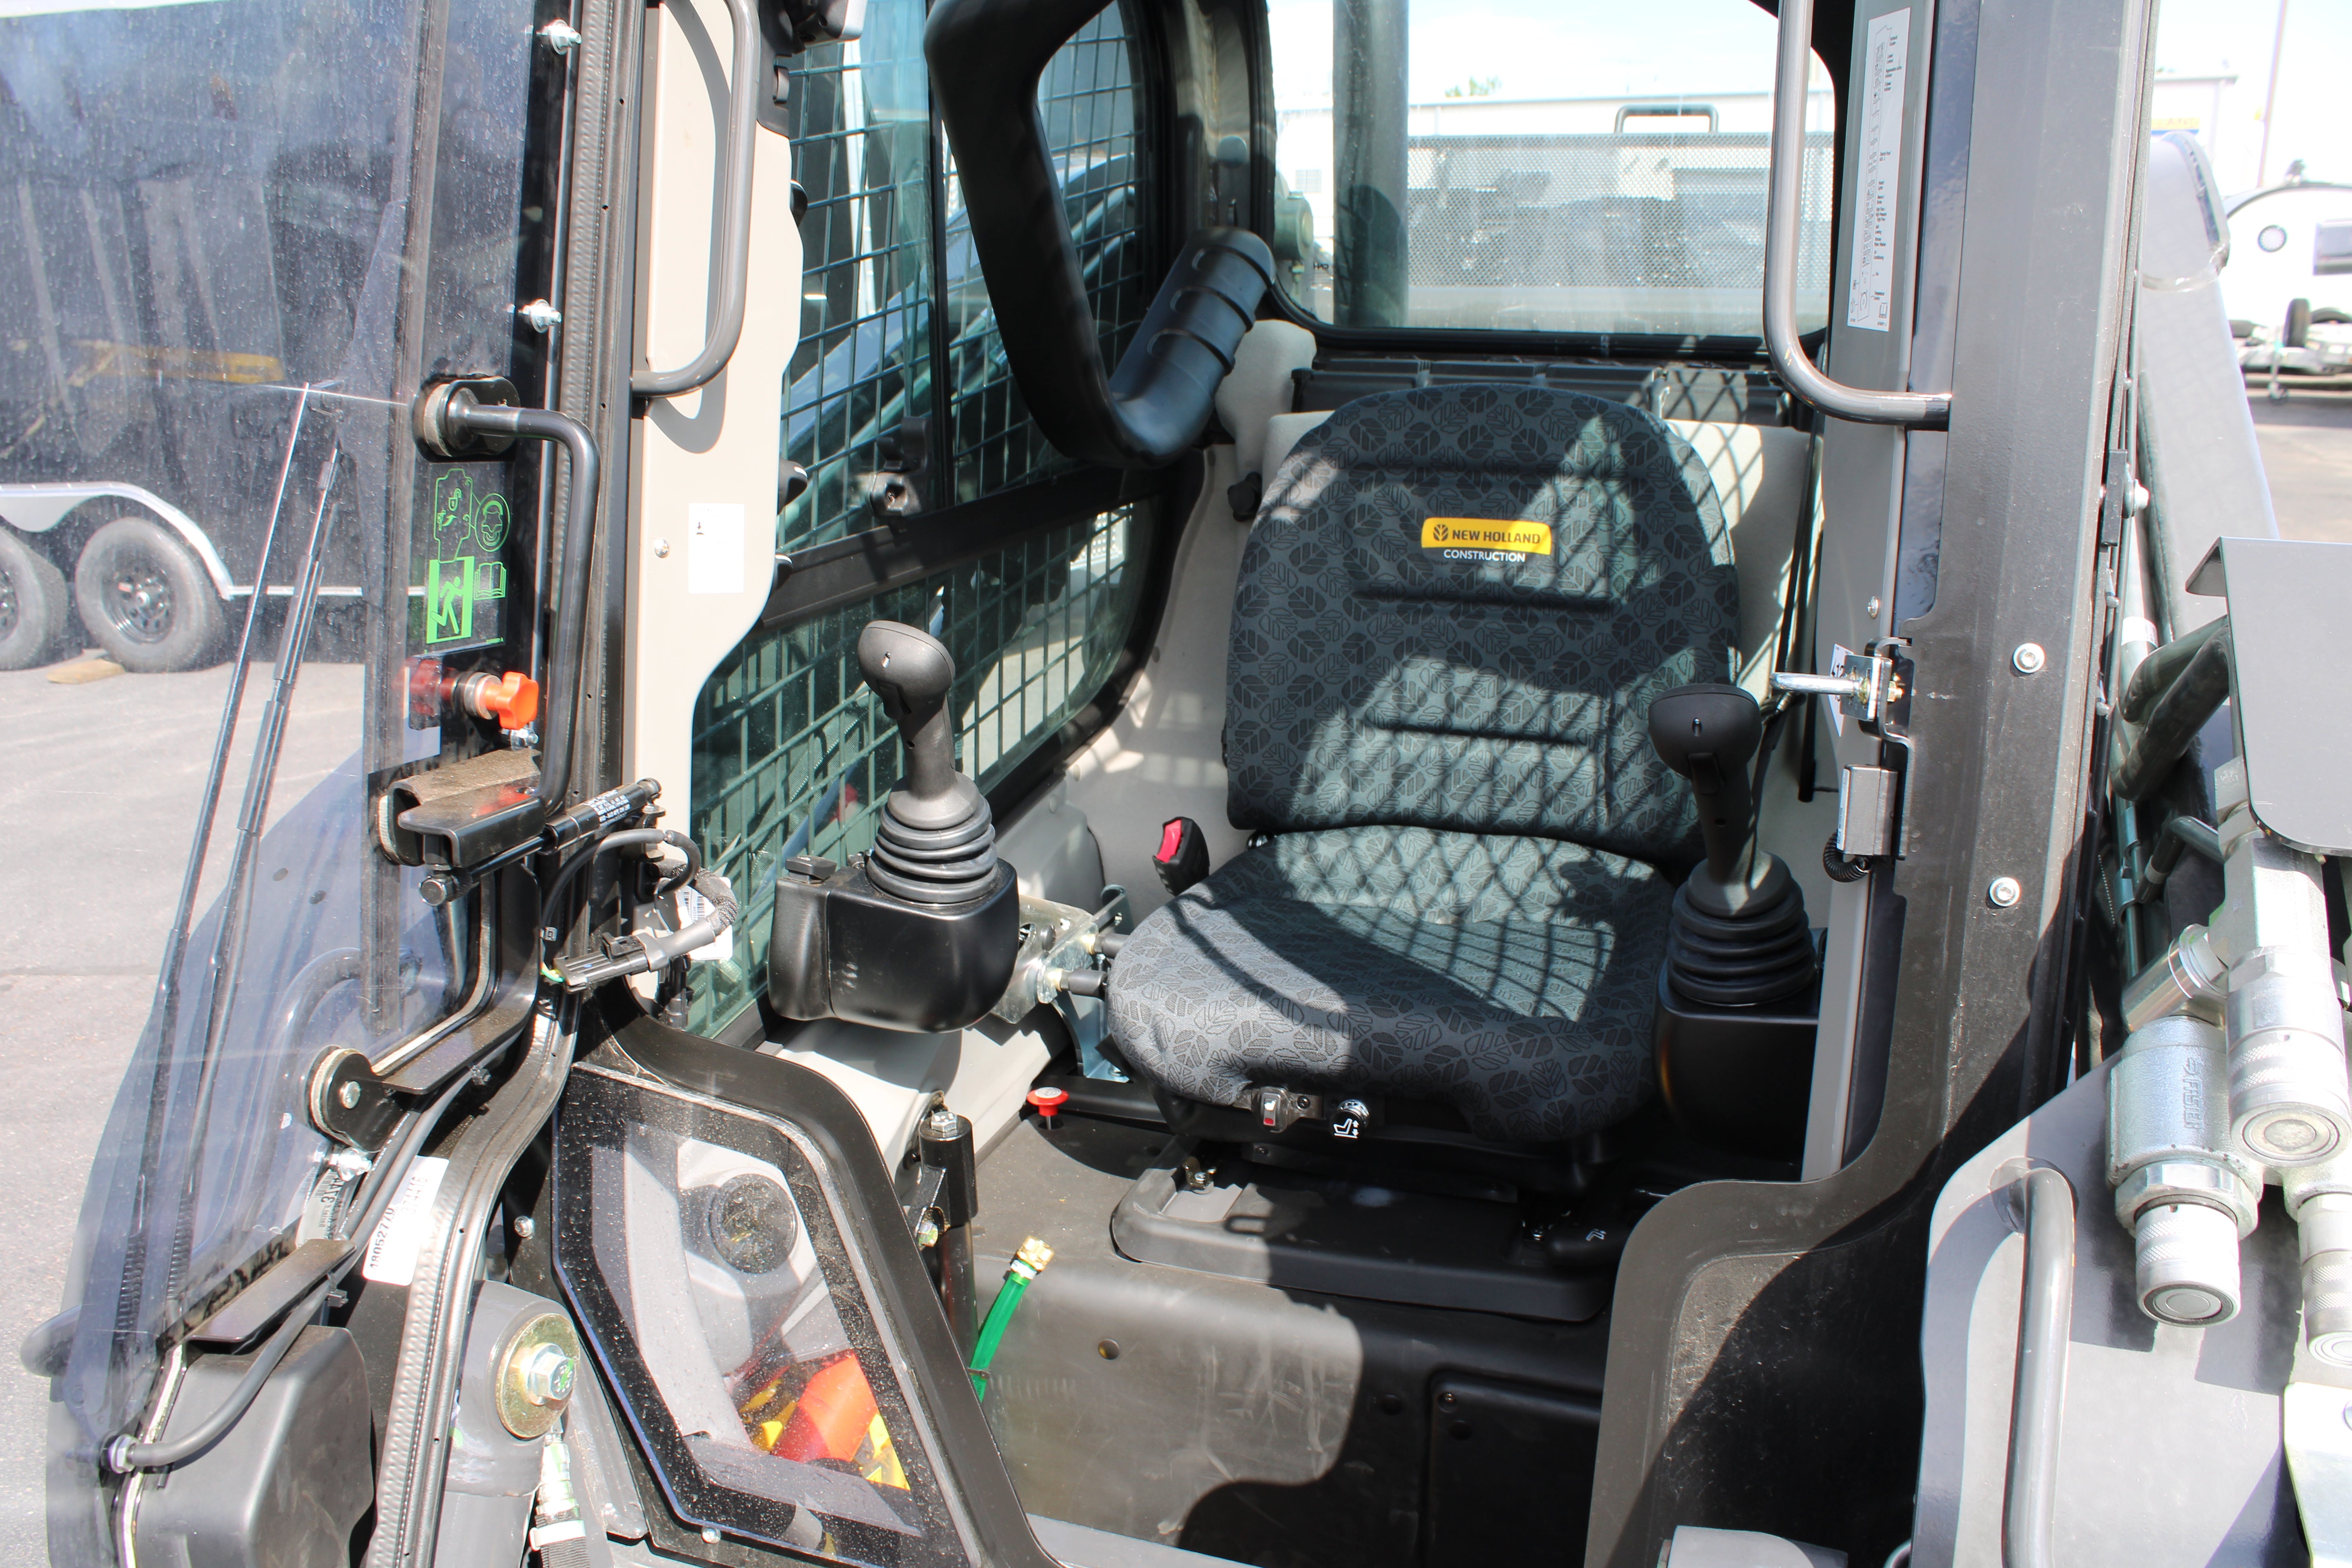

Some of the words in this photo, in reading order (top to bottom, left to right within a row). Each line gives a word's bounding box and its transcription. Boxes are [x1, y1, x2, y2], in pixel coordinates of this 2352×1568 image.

[1452, 530, 1480, 541] NEW
[1483, 531, 1541, 543] HOLLAND
[1443, 549, 1526, 563] CONSTRUCTION
[401, 1176, 428, 1214] 374416
